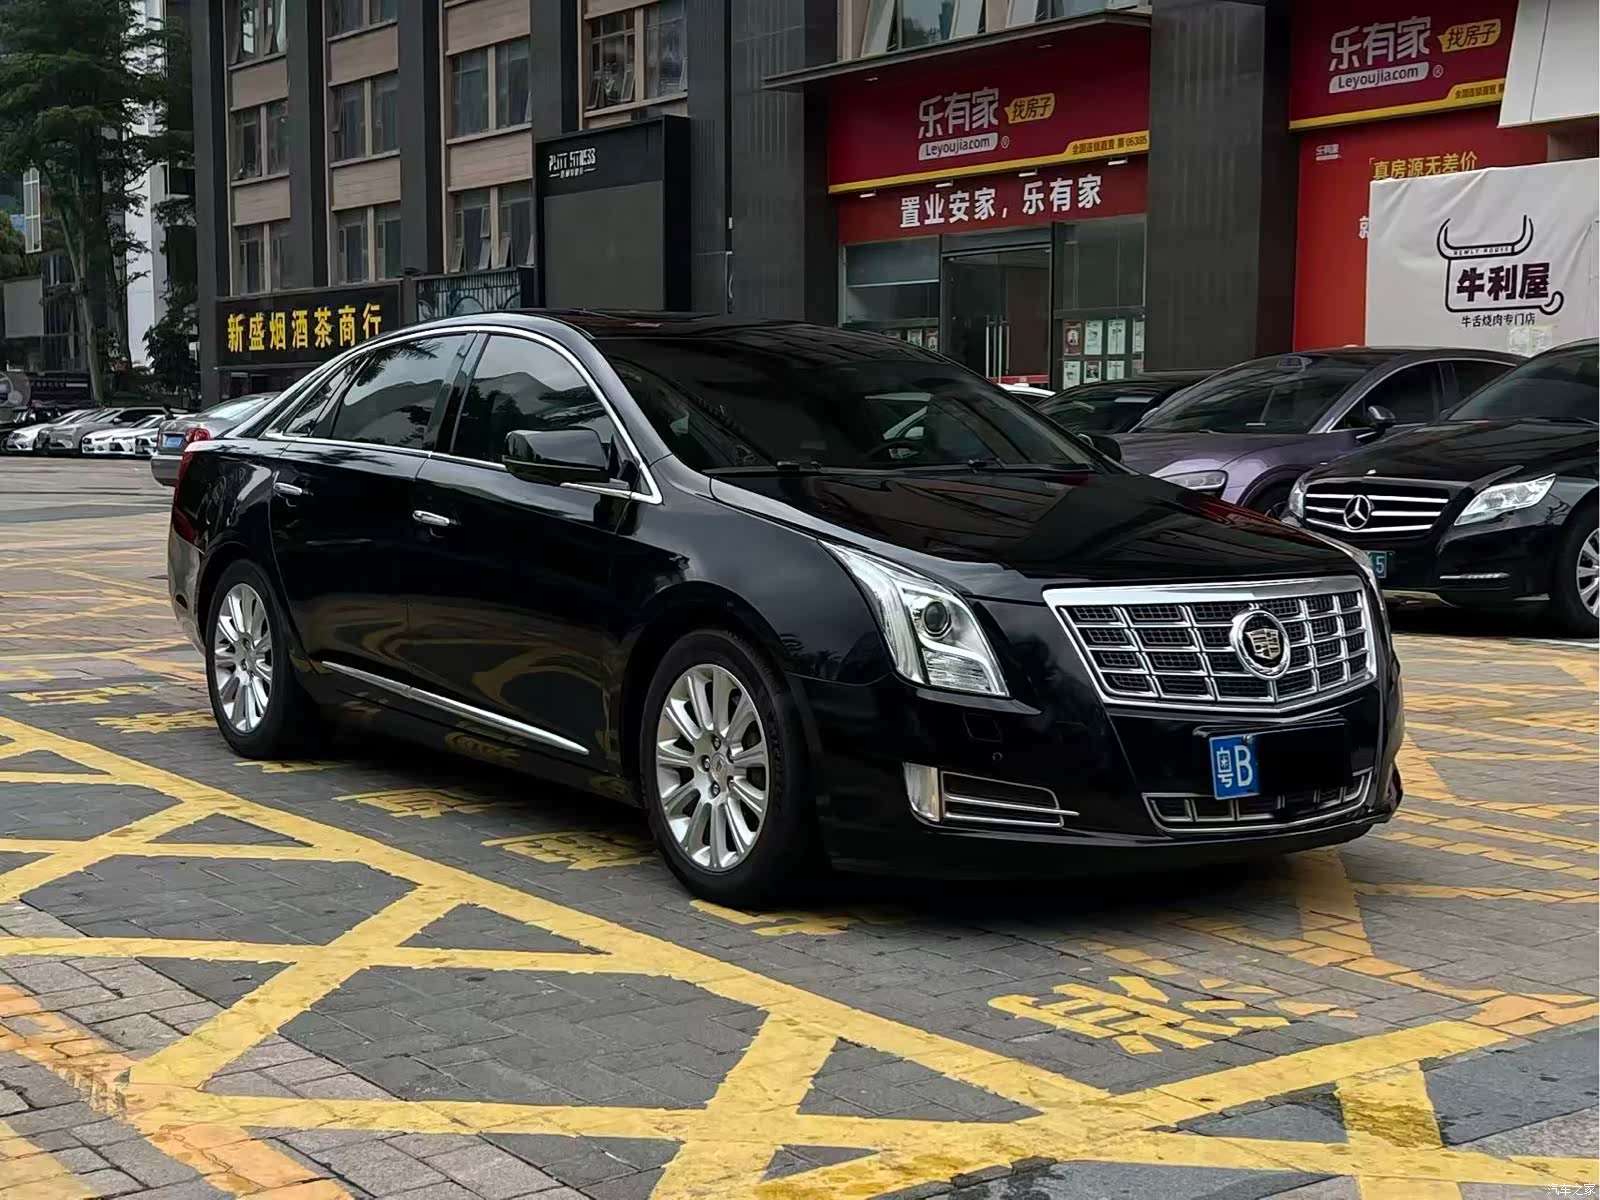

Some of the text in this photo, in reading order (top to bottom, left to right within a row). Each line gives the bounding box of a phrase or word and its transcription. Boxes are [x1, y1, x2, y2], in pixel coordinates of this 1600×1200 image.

[1329, 16, 1431, 71] 乐有家
[1446, 23, 1497, 49] 找房子
[918, 87, 999, 139] 乐有家
[1012, 97, 1052, 121] 找房子
[1456, 262, 1550, 302] 牛利屋
[228, 303, 382, 352] 新盛烟酒茶商行
[1461, 312, 1536, 328] 牛舌烧肉专门店
[1216, 745, 1254, 788] 粤B
